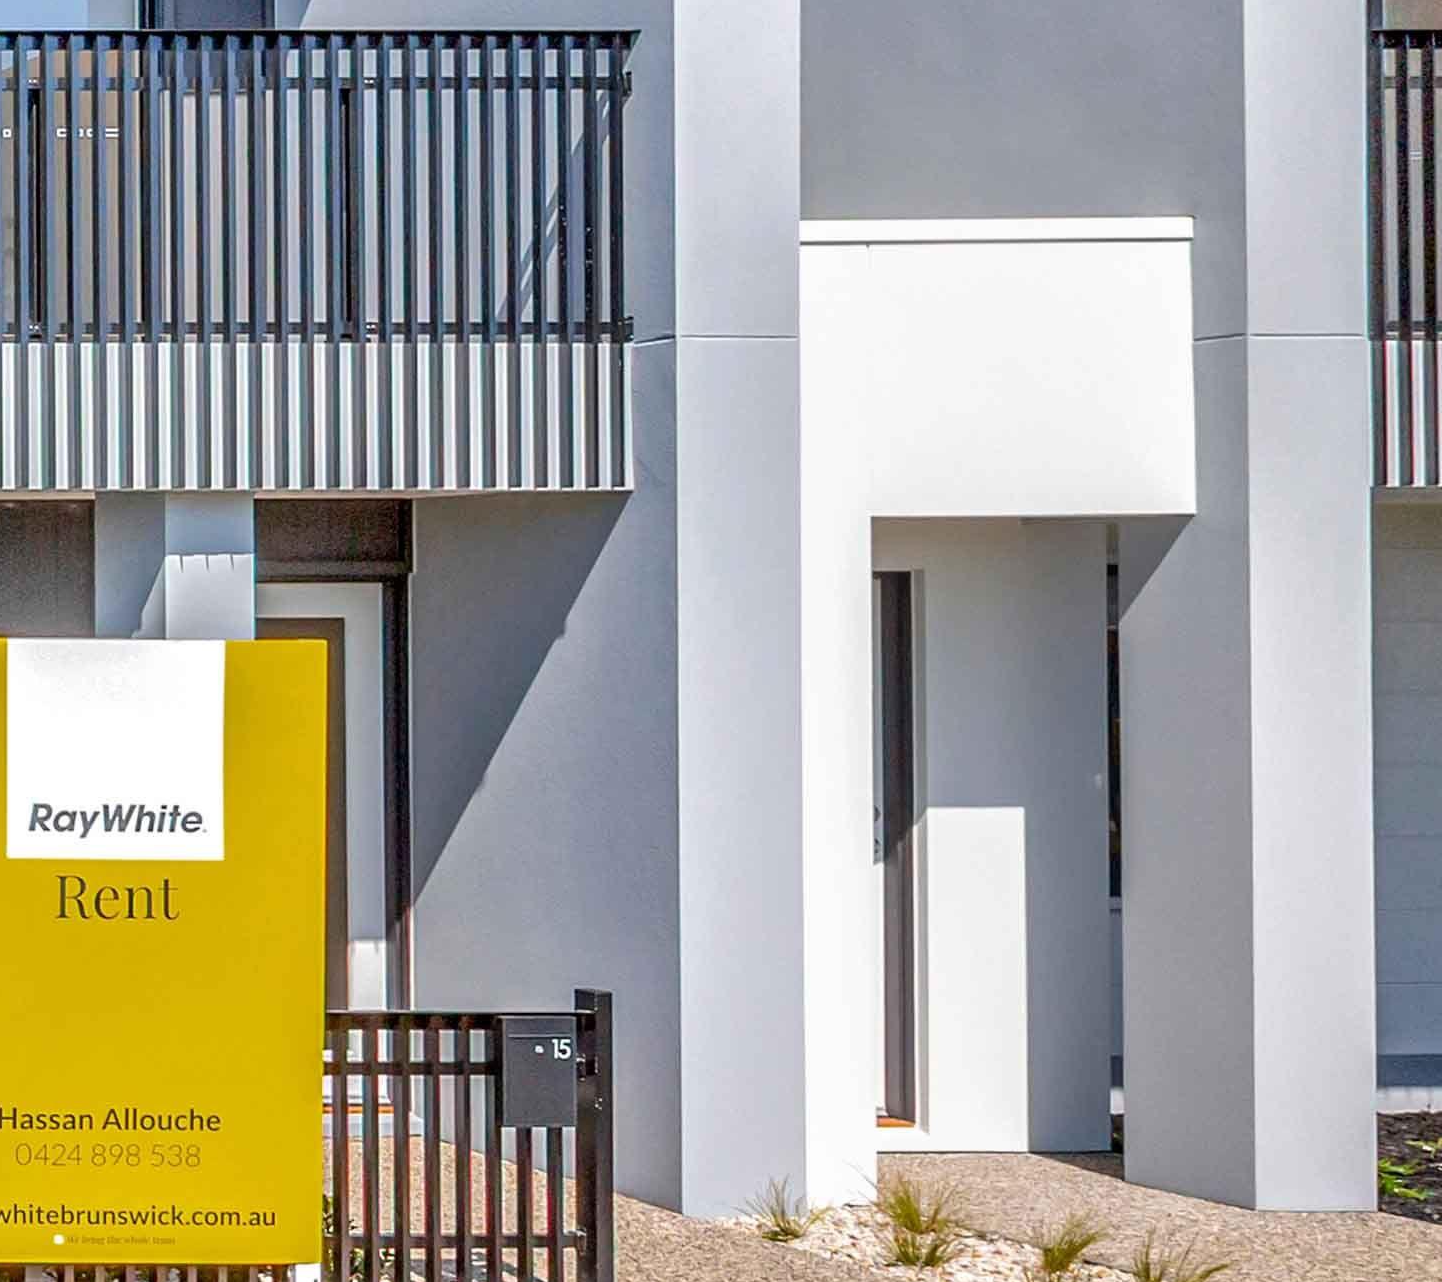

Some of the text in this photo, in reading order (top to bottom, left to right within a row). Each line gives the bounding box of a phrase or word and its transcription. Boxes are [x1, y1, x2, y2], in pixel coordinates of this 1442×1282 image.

[54, 874, 180, 921] Rent
[551, 1038, 572, 1060] 15
[101, 1108, 222, 1132] Allouche
[15, 1143, 202, 1168] 0424 898 538
